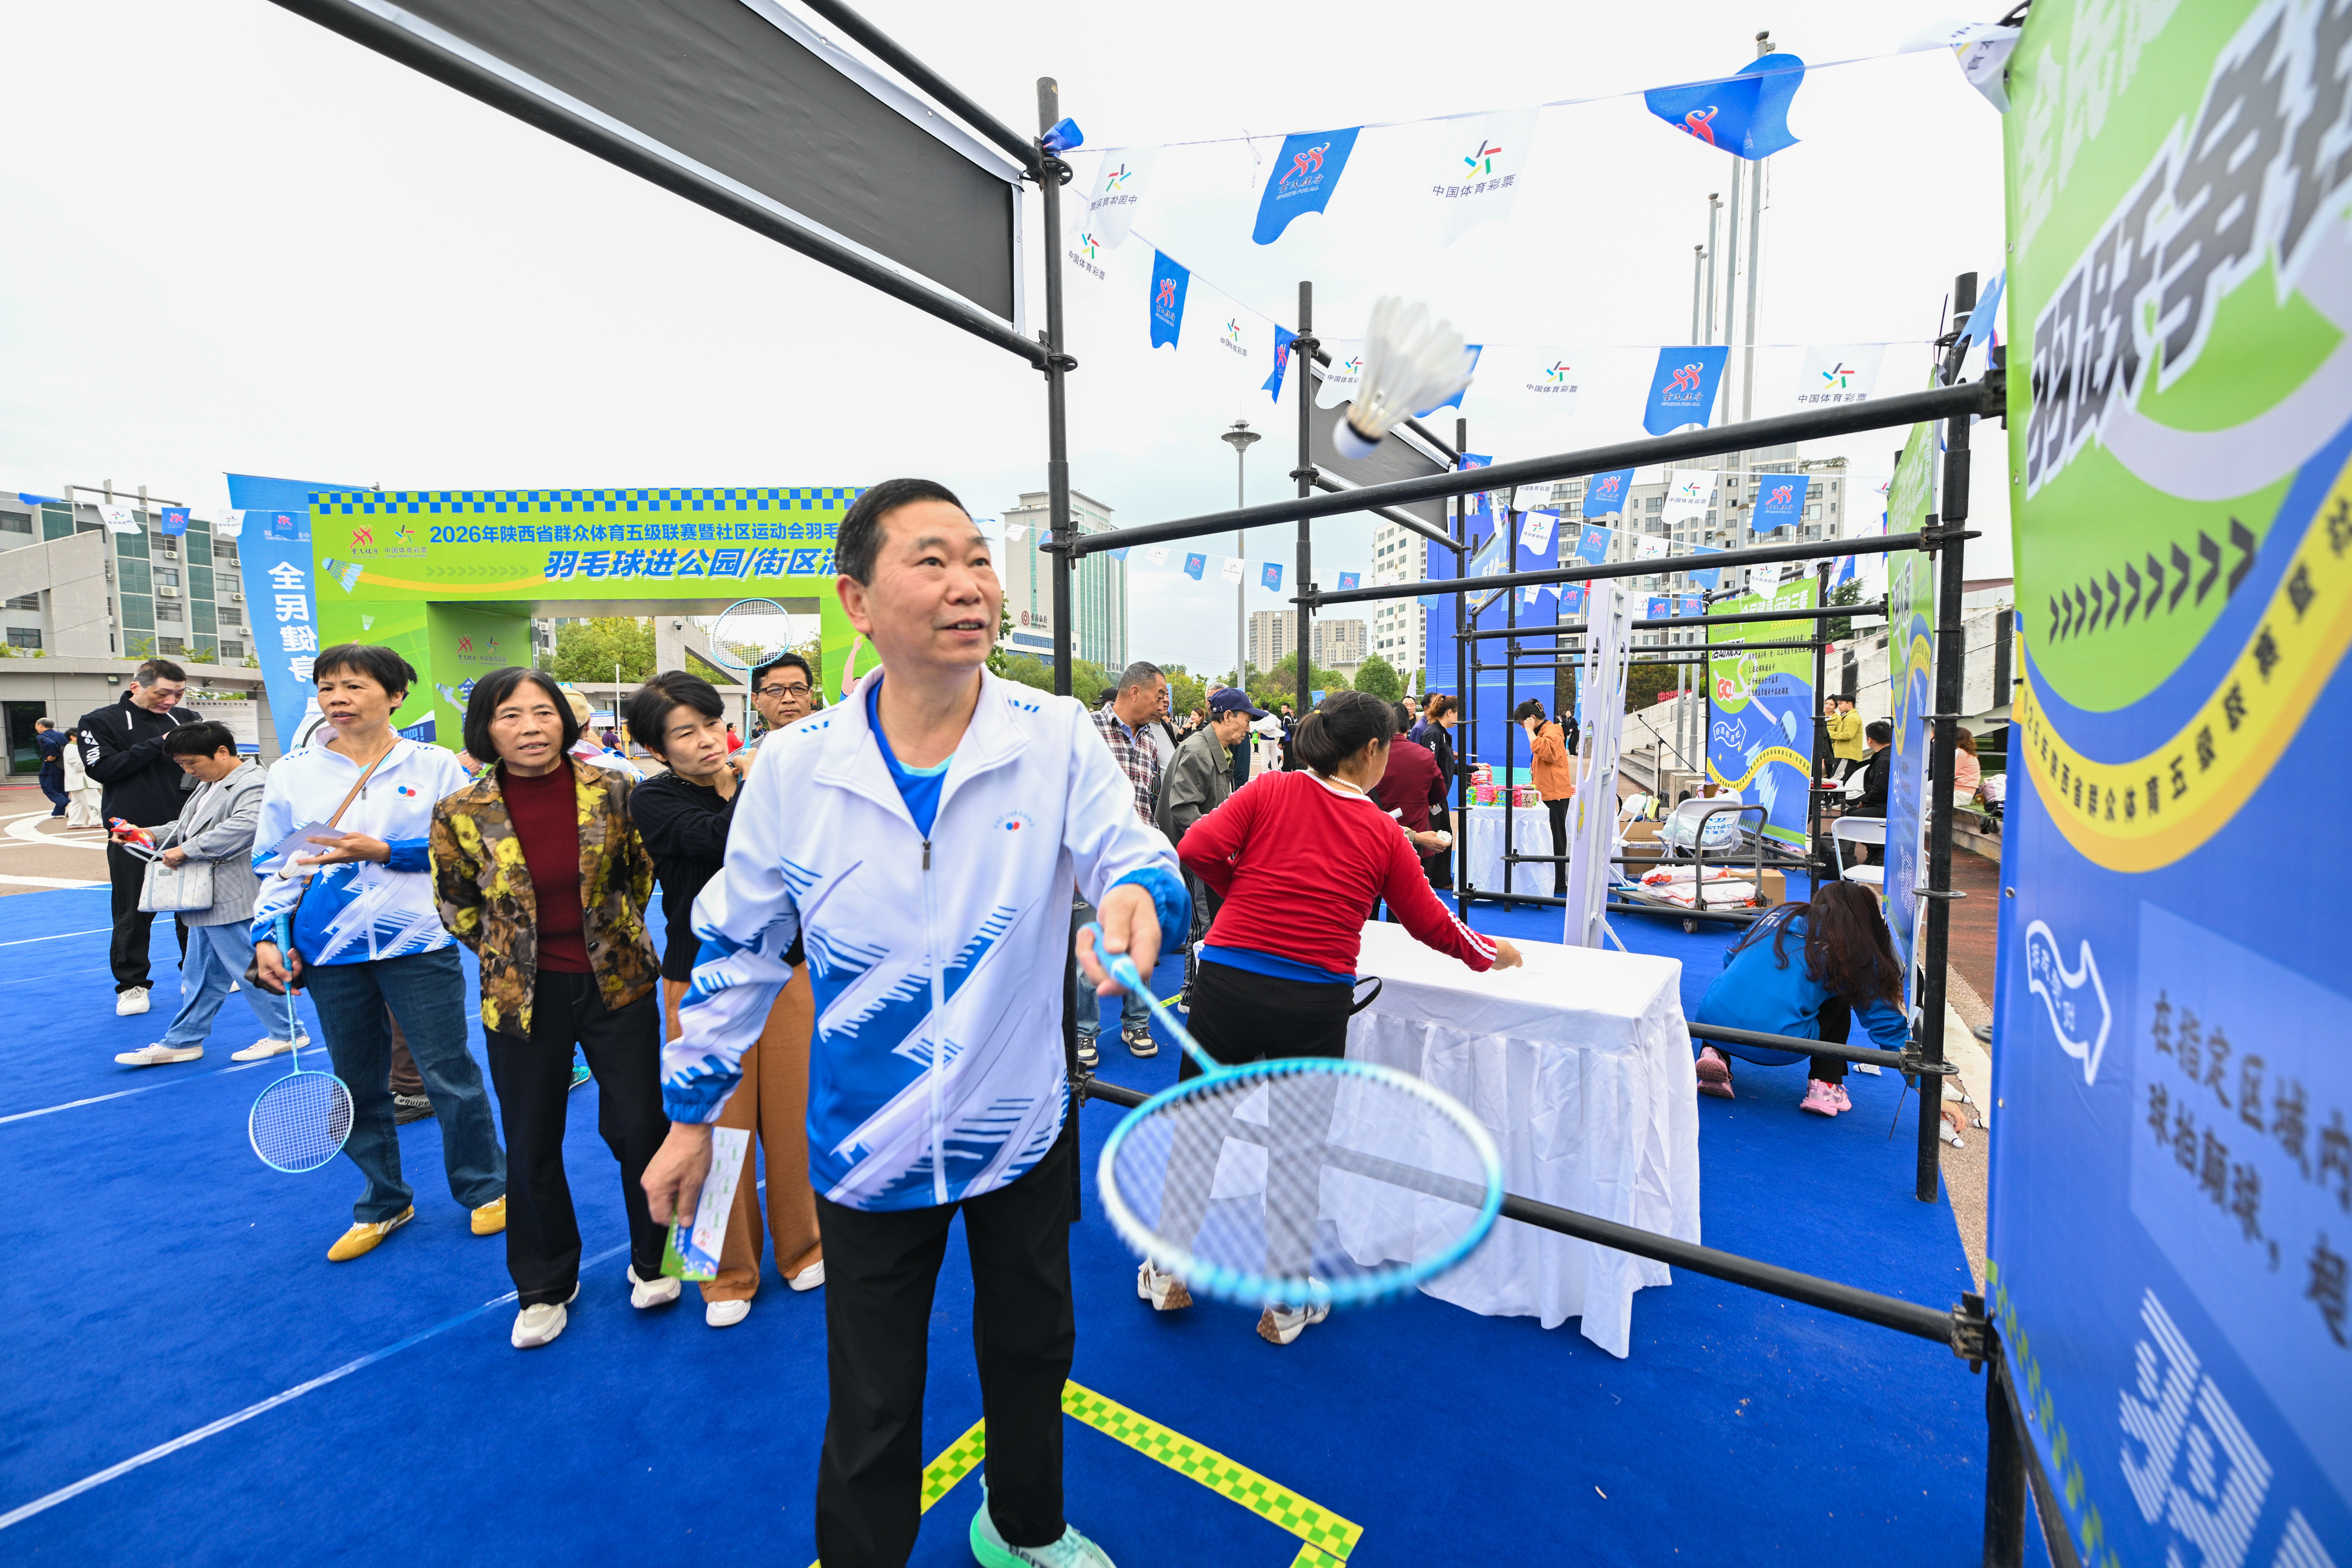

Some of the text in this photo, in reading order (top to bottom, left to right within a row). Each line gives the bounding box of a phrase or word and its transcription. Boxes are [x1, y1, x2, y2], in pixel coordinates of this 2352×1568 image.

[1433, 174, 1516, 198] 中国体育彩票
[1068, 250, 1105, 280] 中国体育彩票
[1526, 383, 1578, 393] 中国体育彩票
[1663, 392, 1703, 402] 全民健身
[1798, 393, 1867, 403] 中国体育彩票
[430, 522, 837, 543] 2026年陕西省群众体育五级联赛暨社区运动会羽毛
[86, 745, 101, 767] YON
[400, 1098, 432, 1106] equipe
